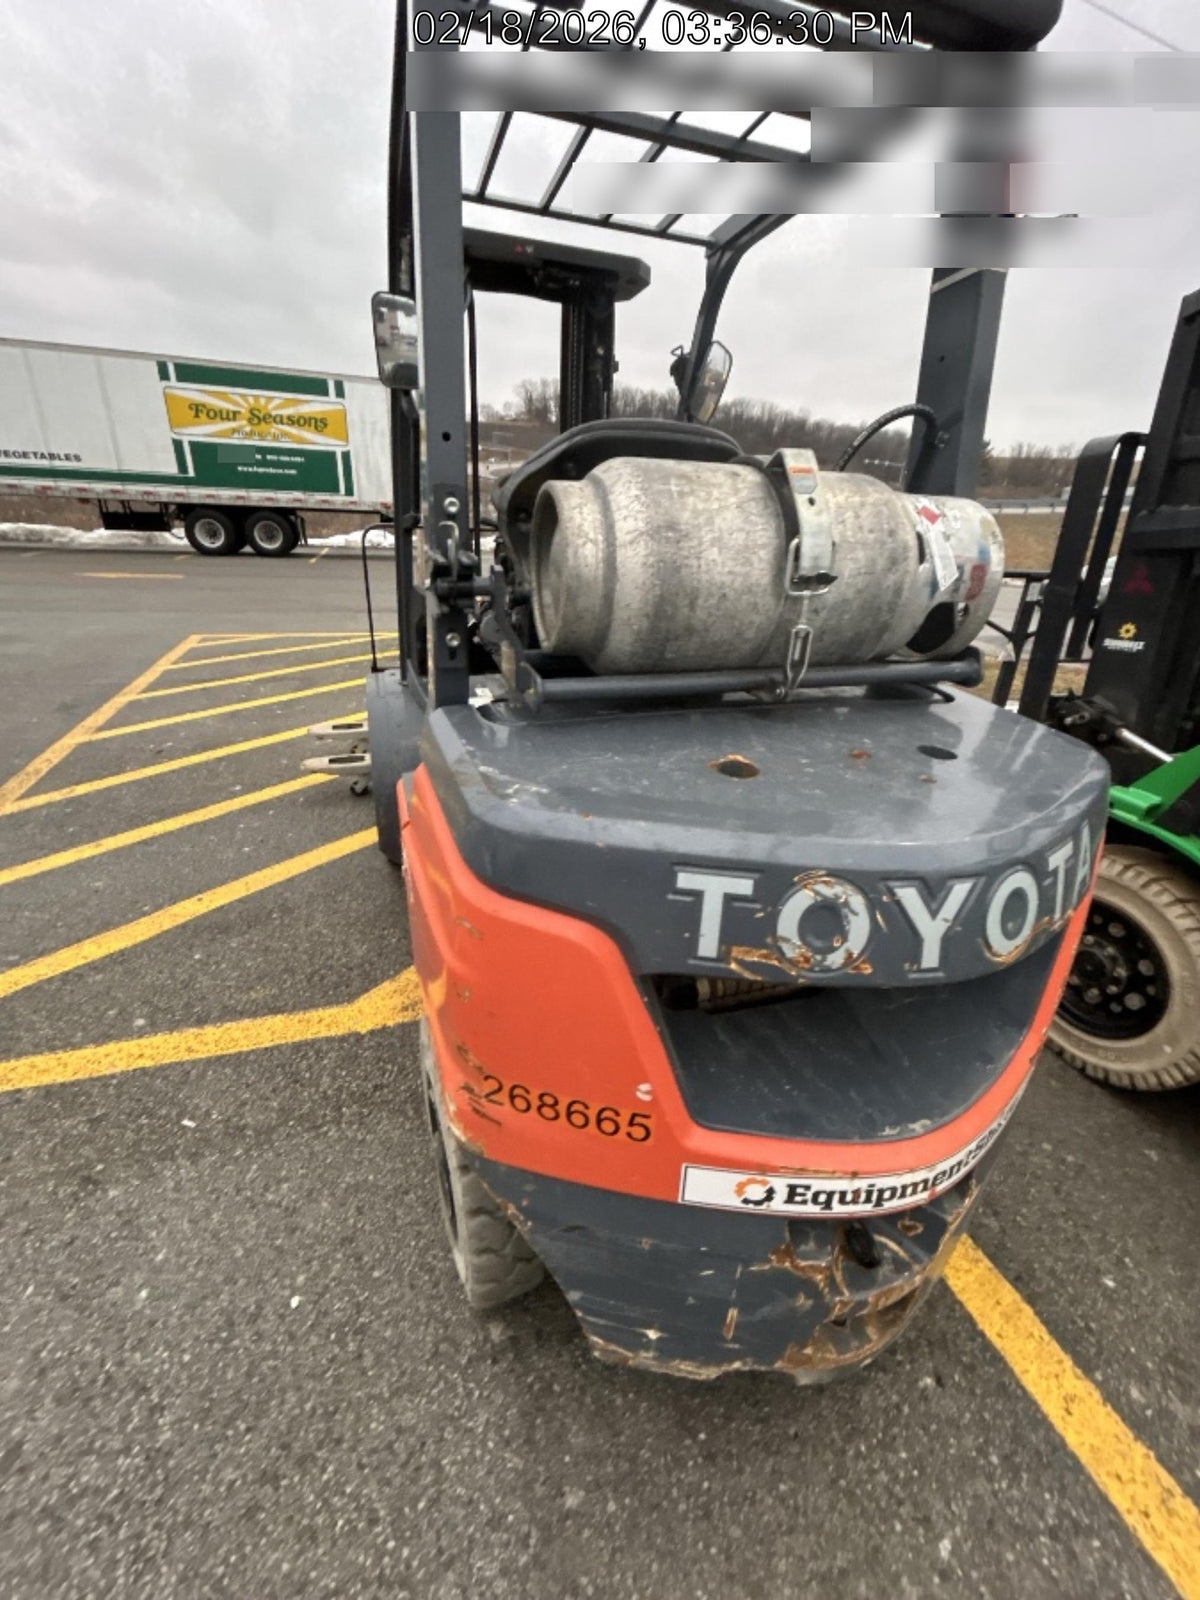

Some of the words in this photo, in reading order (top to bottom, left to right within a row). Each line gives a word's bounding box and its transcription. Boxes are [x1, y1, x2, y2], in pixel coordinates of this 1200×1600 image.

[188, 402, 242, 422] Four
[246, 408, 329, 433] Seasons
[675, 819, 1091, 971] TOYOTA
[482, 1074, 652, 1143] 268665
